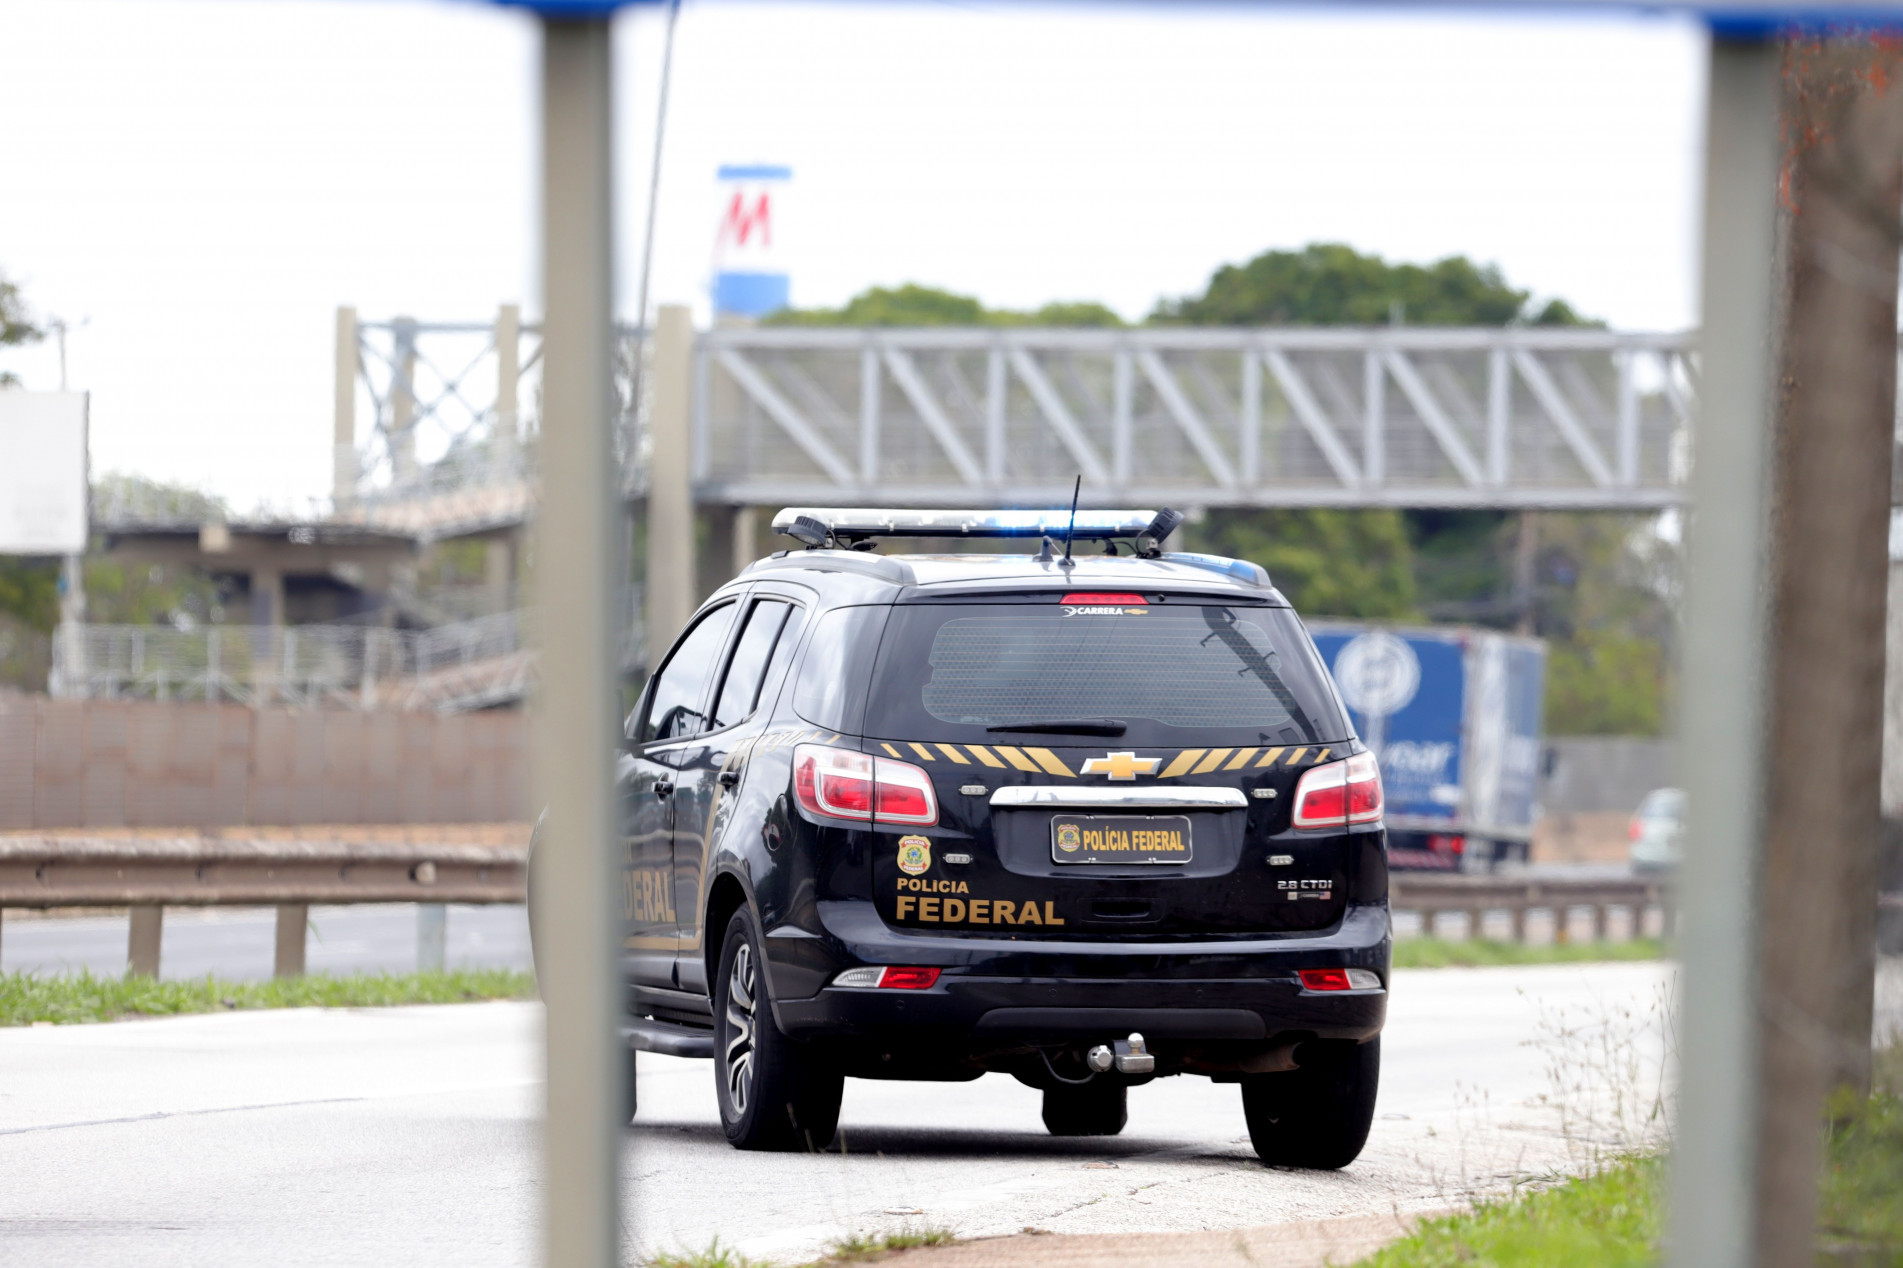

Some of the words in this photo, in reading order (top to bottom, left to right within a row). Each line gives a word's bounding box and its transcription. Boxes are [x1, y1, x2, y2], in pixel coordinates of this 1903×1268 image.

[1077, 607, 1123, 615] CARRERA
[1083, 825, 1130, 851] POLÍCIA
[1132, 830, 1185, 851] FEDERAL
[623, 871, 676, 922] DERAL
[896, 895, 1065, 926] FEDERAL
